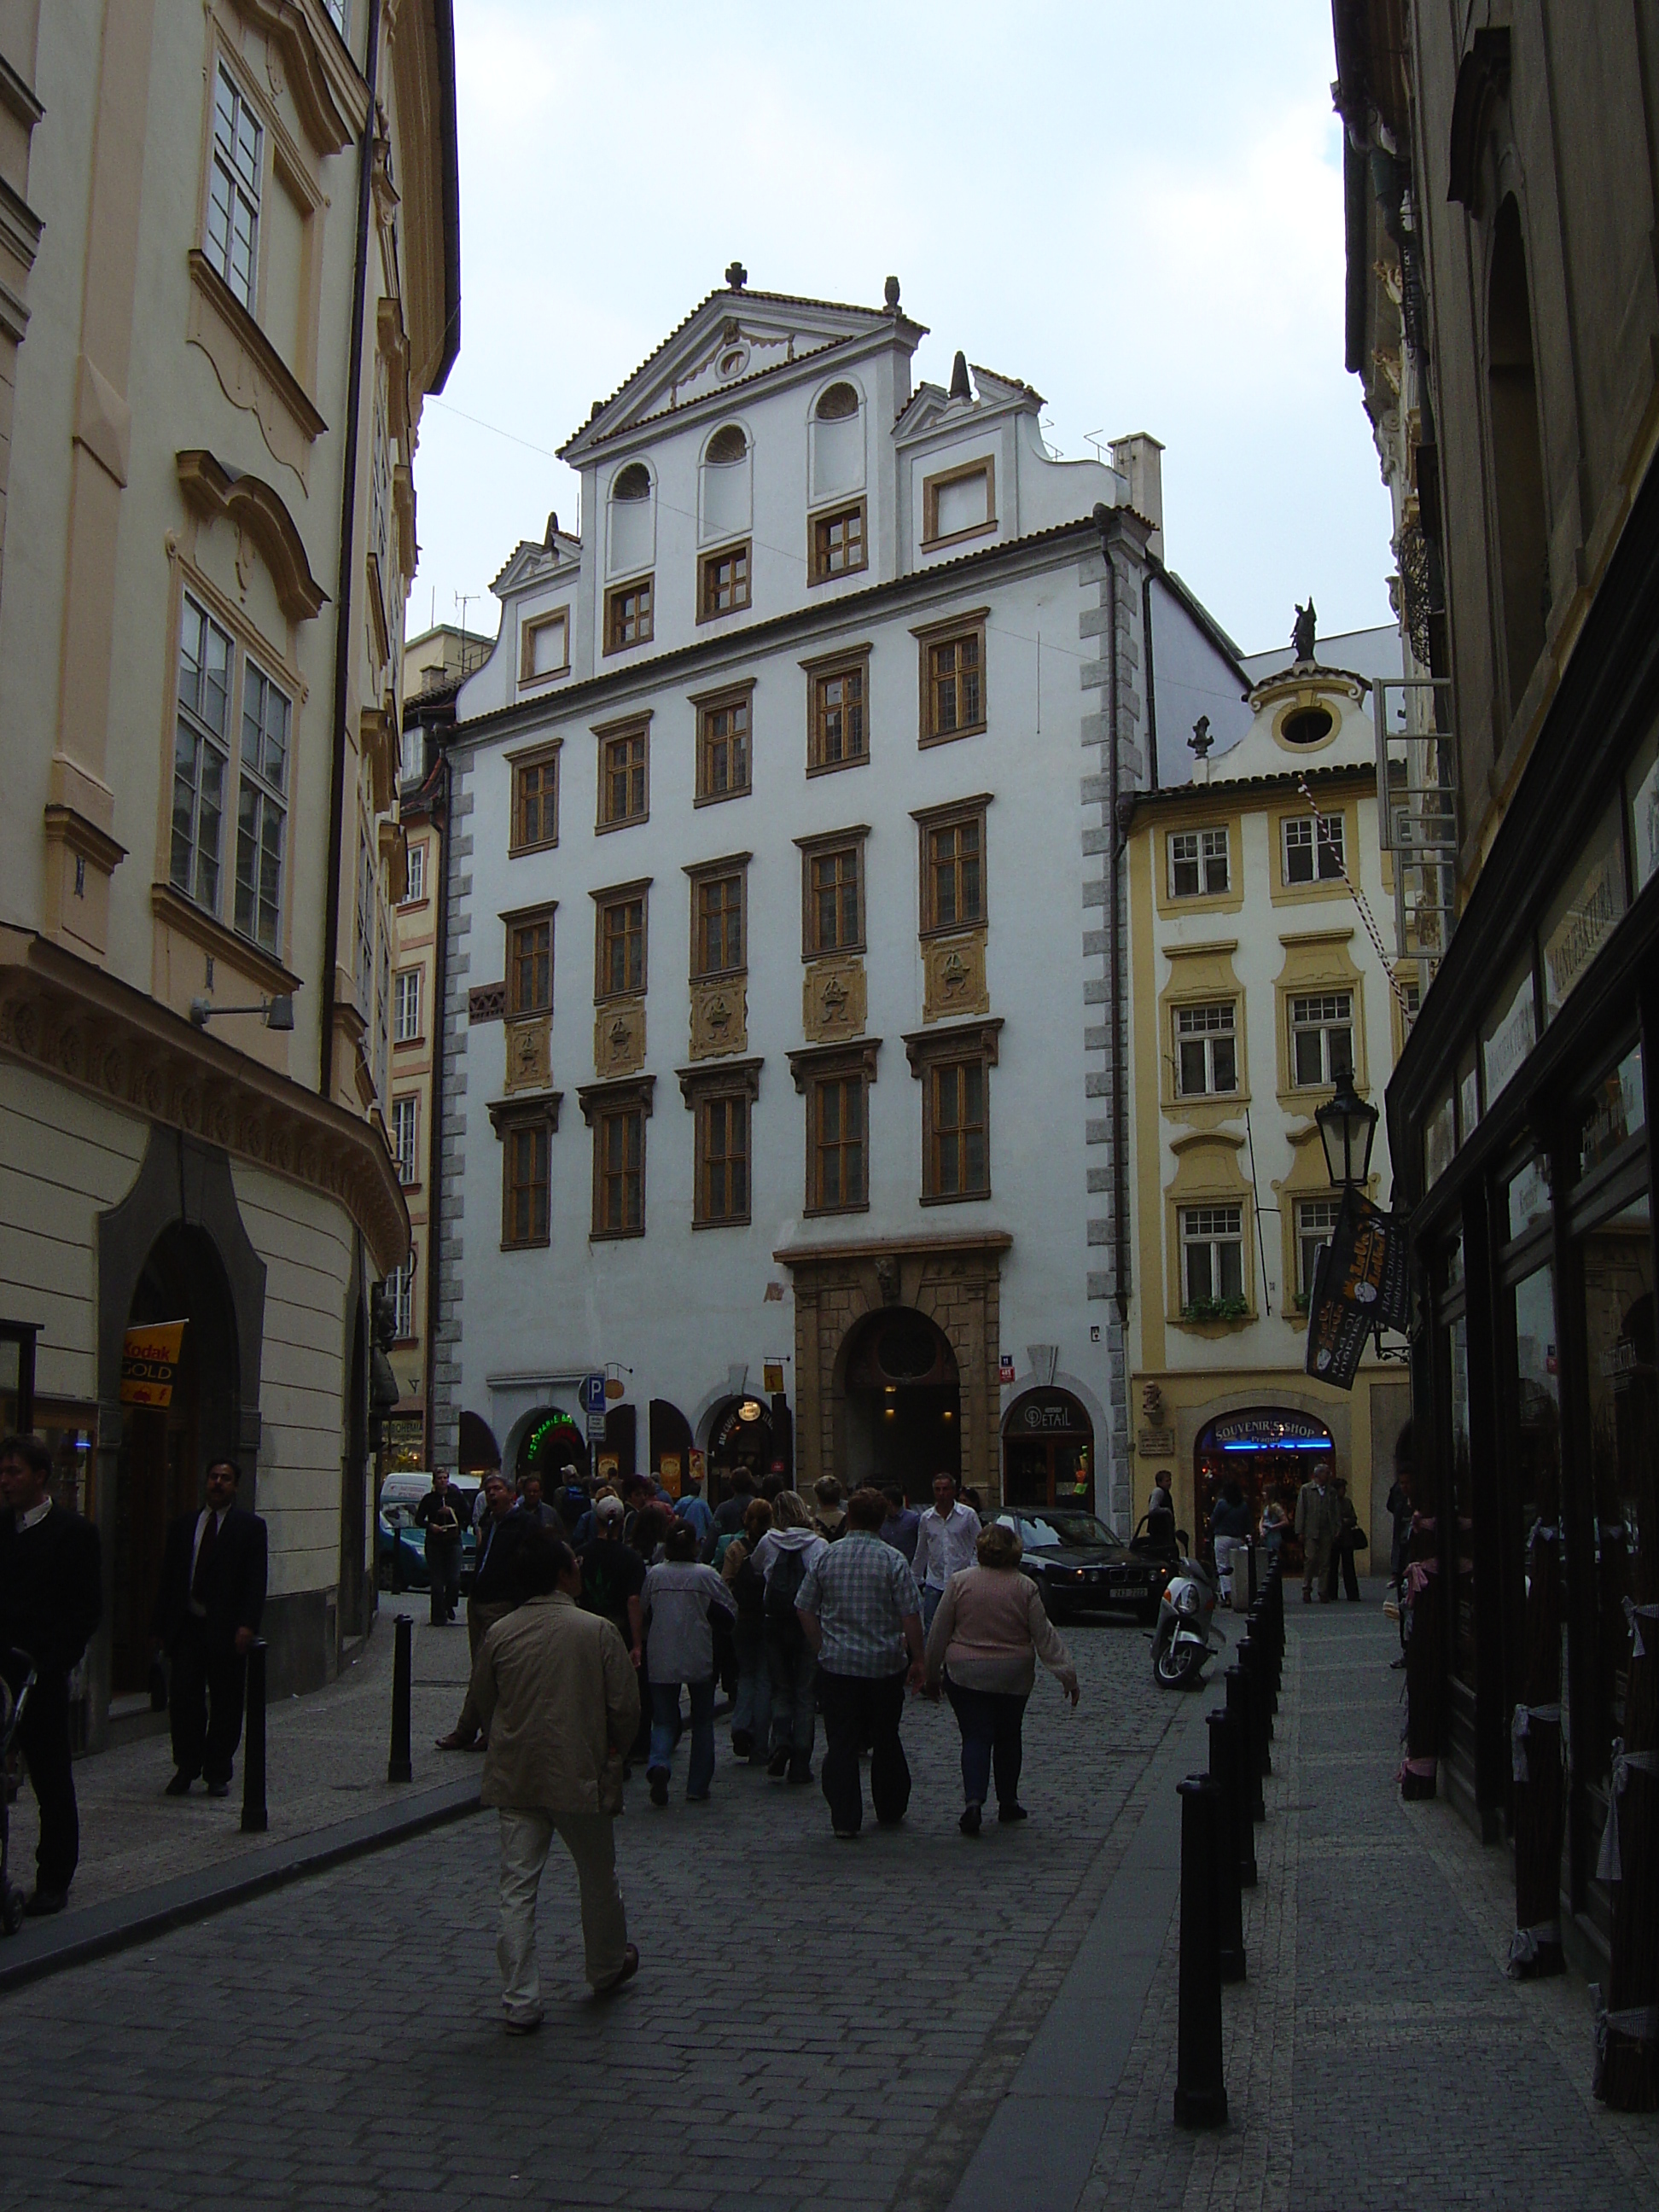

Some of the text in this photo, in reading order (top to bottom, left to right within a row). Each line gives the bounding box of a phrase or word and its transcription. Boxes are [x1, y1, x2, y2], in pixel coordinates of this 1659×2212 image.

[124, 1341, 171, 1363] Kodak
[122, 1362, 172, 1380] GOLD
[591, 1379, 602, 1401] P
[1024, 1406, 1072, 1428] DETAIL
[1215, 1420, 1315, 1442] SOUVENIR'S SHOP
[1251, 1435, 1281, 1445] Prague
